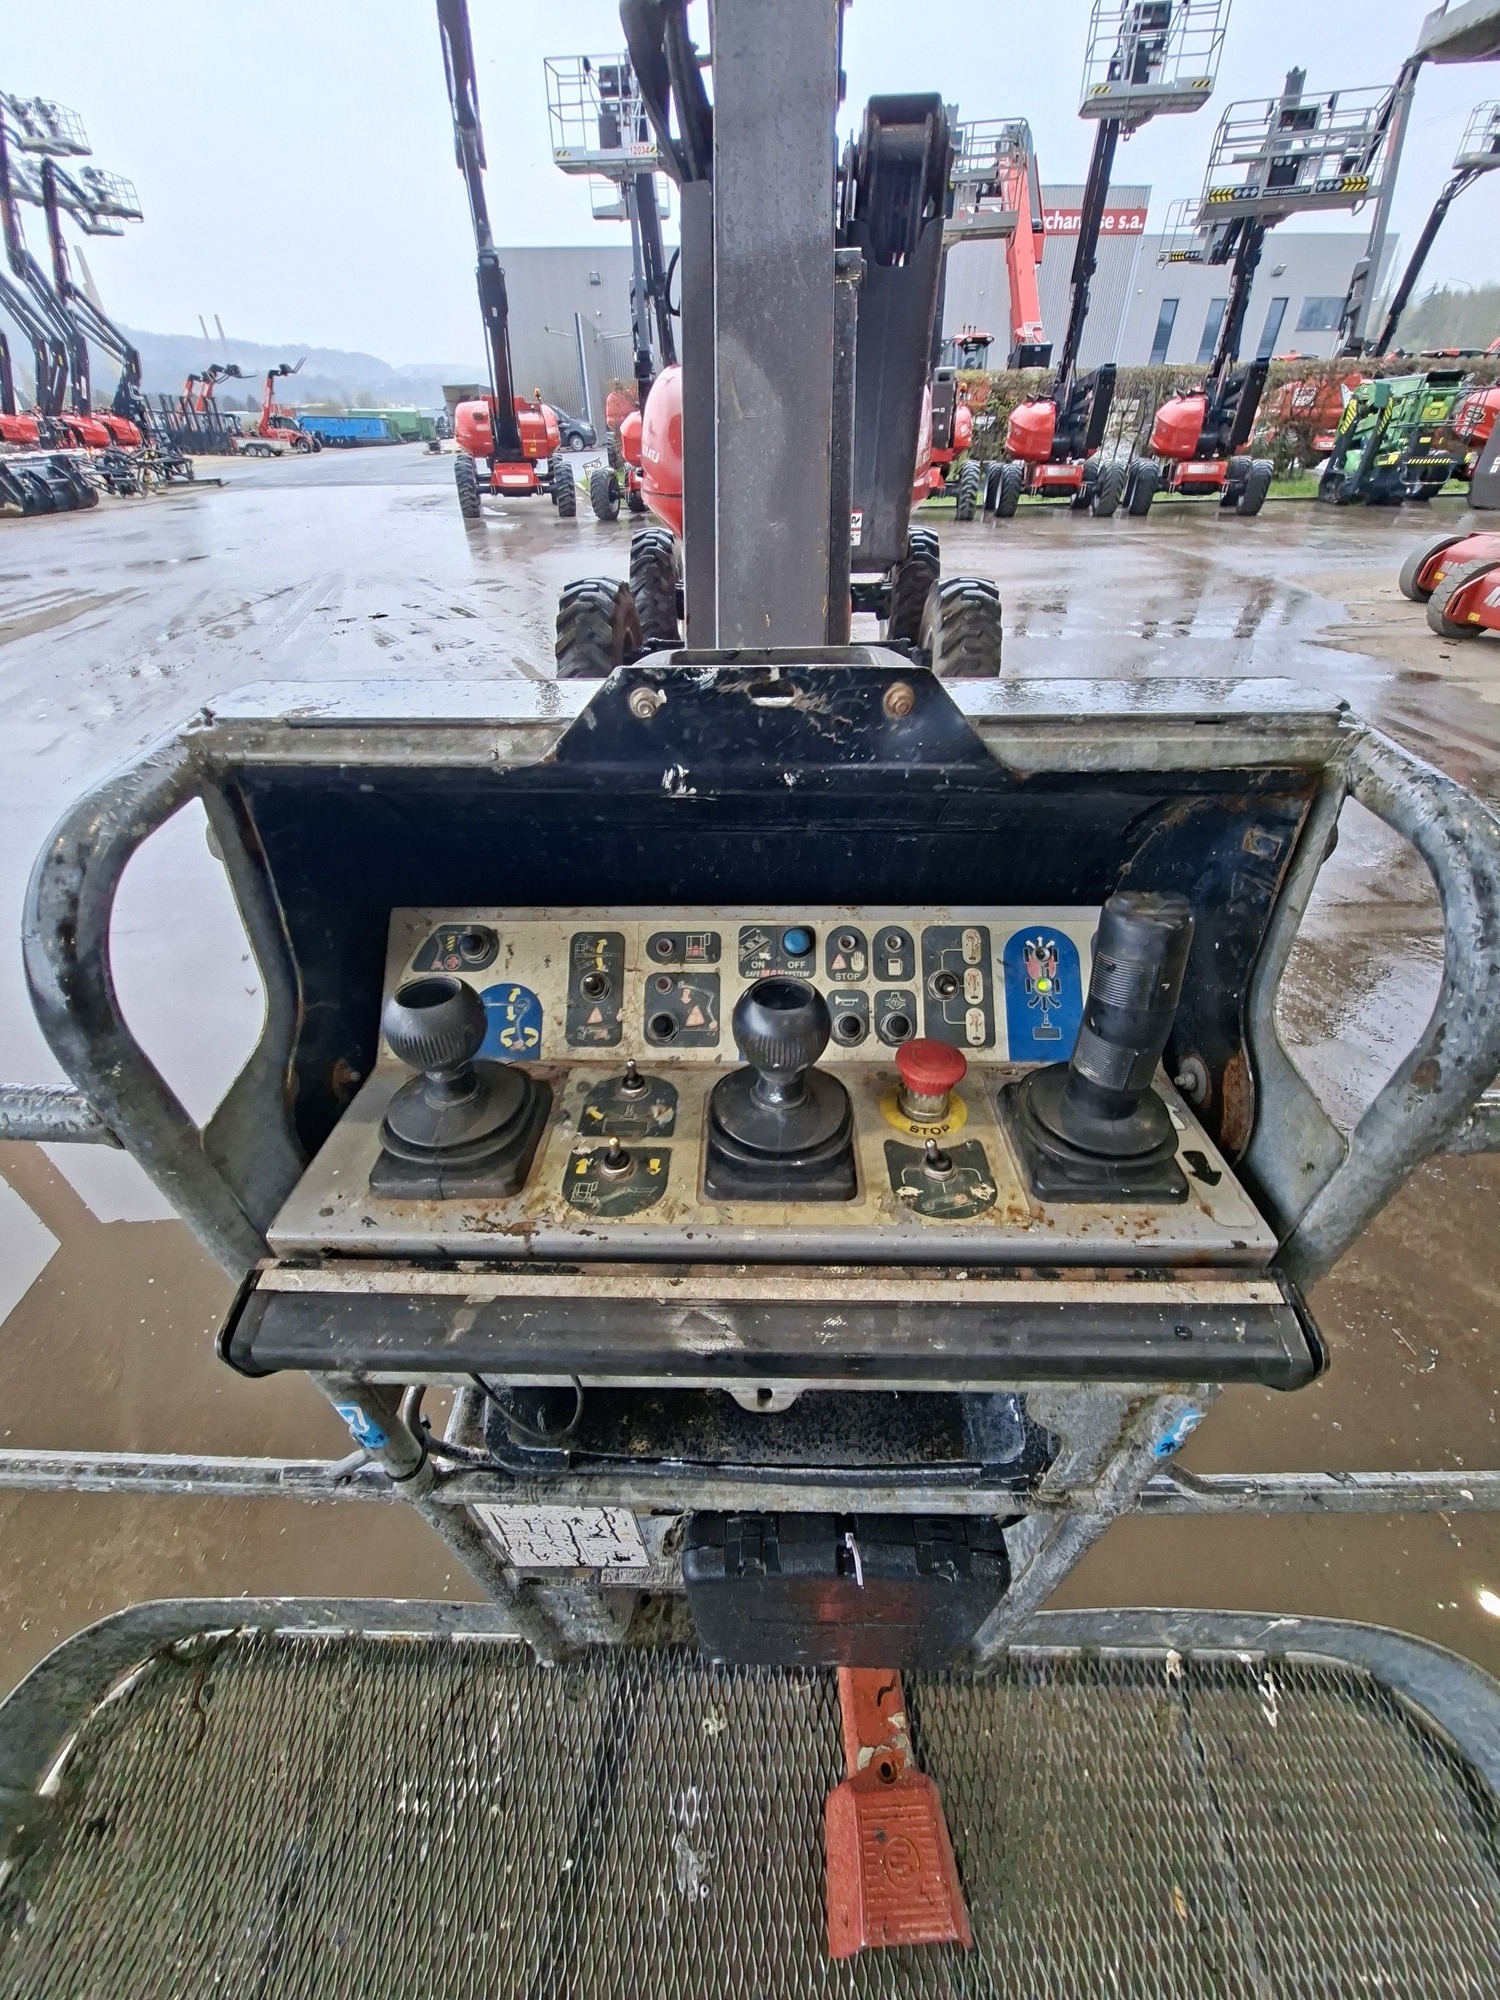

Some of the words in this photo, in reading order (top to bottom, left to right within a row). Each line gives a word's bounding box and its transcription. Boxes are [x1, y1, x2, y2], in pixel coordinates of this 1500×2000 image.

[1117, 214, 1144, 230] s.a.
[750, 961, 765, 969] ON
[787, 961, 806, 969] OFF
[835, 972, 861, 981] STOP
[909, 1124, 950, 1135] STOP
